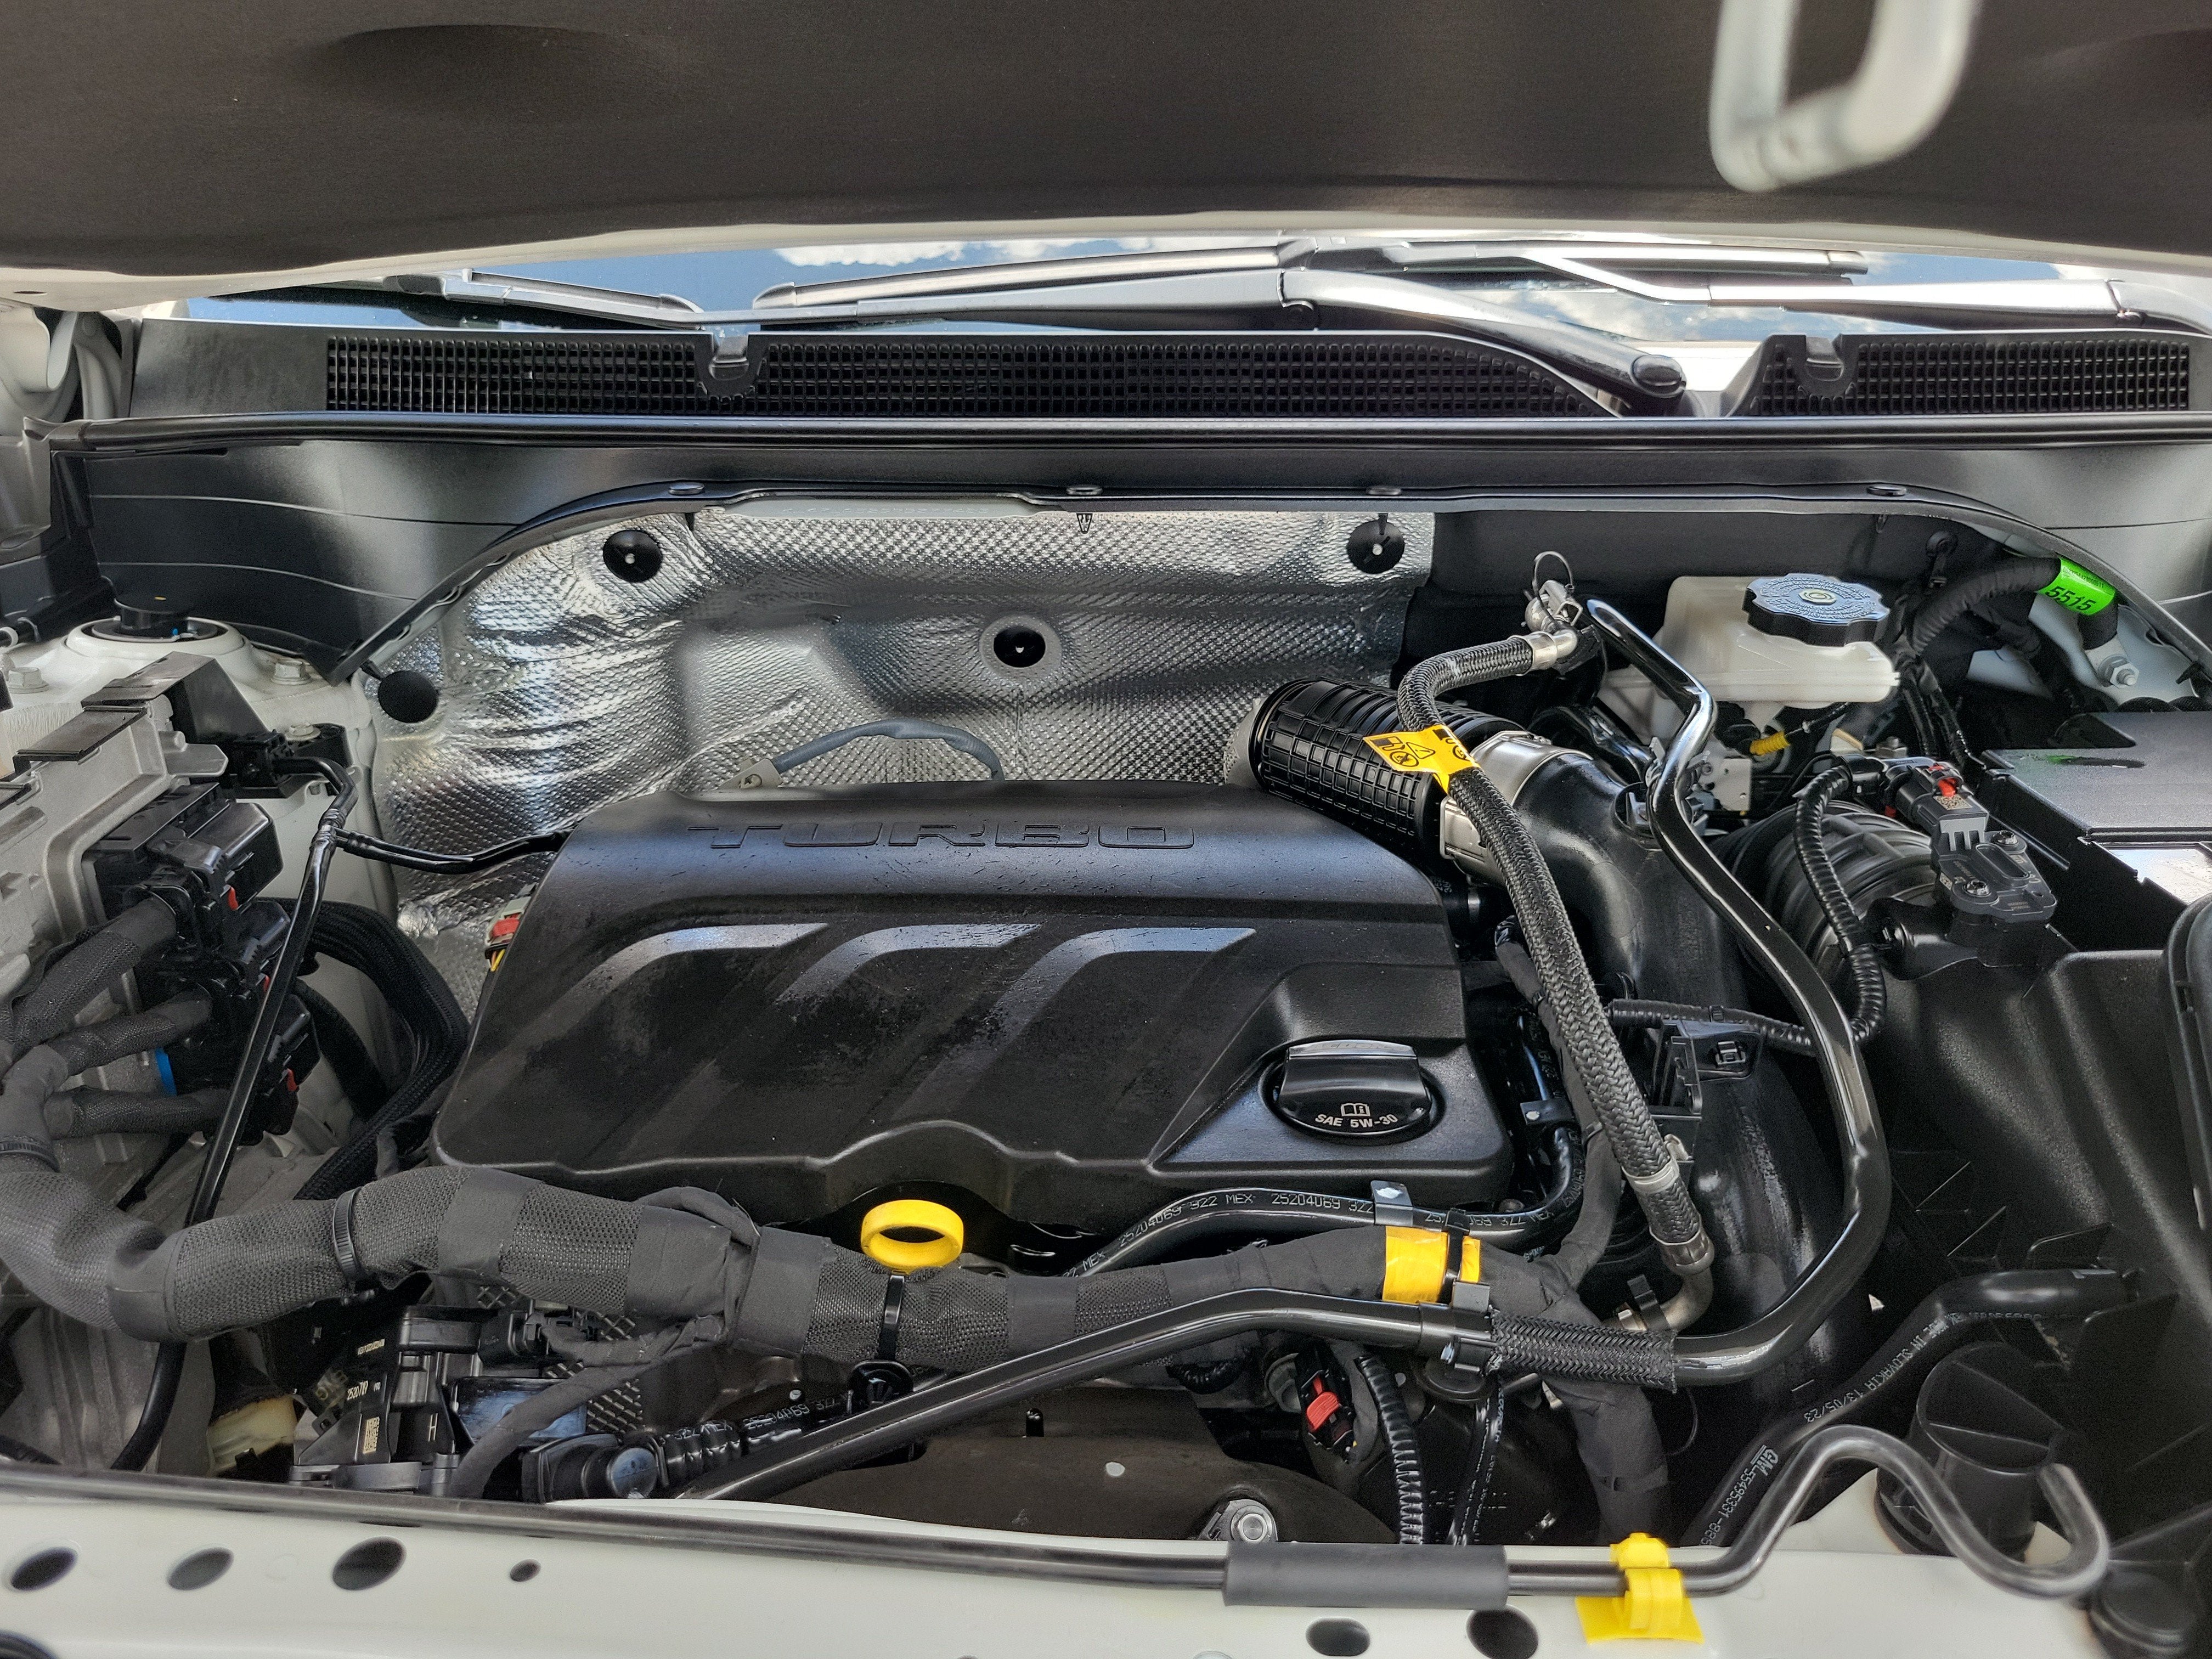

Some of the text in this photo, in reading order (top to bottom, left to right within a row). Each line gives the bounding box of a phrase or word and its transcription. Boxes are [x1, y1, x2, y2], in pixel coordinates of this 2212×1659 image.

[2045, 586, 2096, 611] 5515
[687, 821, 1195, 849] TURBO
[1315, 1114, 1398, 1128] SAE 5W-30
[1082, 1251, 1105, 1271] MEX
[1226, 1193, 1256, 1204] MEX
[1271, 1193, 1340, 1210] 25204069
[1864, 1348, 1914, 1391] SLOVAKIA
[1804, 1389, 1864, 1423] 13/05/23
[428, 1412, 438, 1442] H
